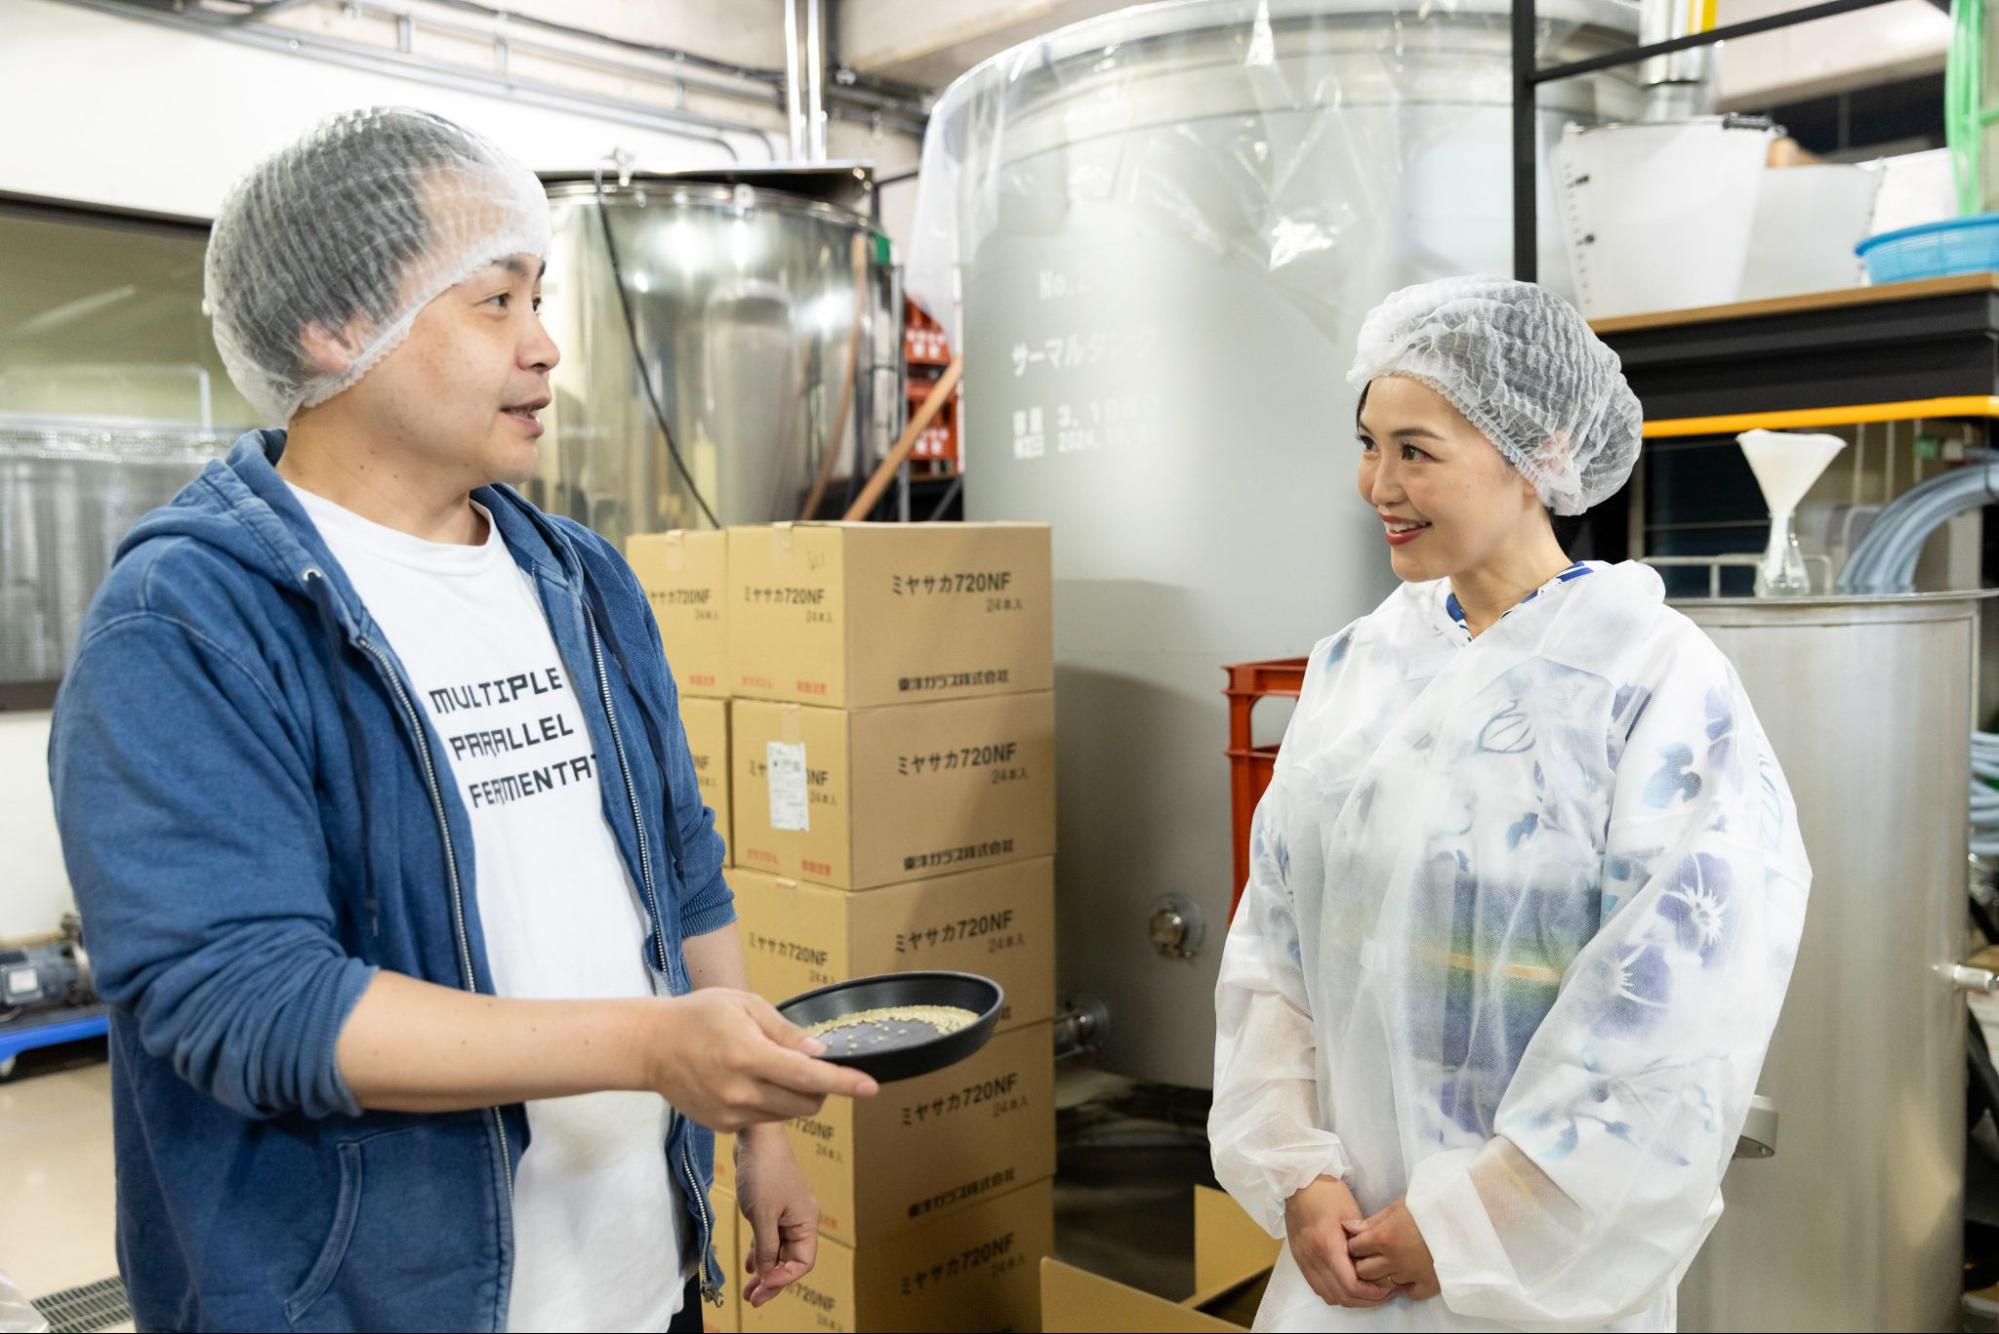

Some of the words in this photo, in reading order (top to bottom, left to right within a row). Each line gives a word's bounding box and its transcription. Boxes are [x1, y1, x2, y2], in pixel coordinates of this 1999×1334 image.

[744, 586, 825, 604] ミヤサカ720NF
[892, 571, 1011, 596] ミヤサカ720NF
[986, 598, 1023, 613] 24本入
[428, 666, 563, 714] MULTIPLE
[898, 669, 1010, 692] 東洋ガラス株式会社
[448, 713, 575, 761] PARALLEL
[898, 742, 1018, 776] ミヤサカ720NF
[991, 767, 1029, 785] 24本入
[467, 752, 597, 809] FERMENTA
[749, 931, 827, 967] ミヤサカ720NF
[895, 909, 1014, 954] ミヤサカ720NF
[988, 932, 1028, 954] 24本入
[901, 1071, 1018, 1127] ミヤサカ720NF
[901, 1231, 1015, 1296] ミヤサカ720NF
